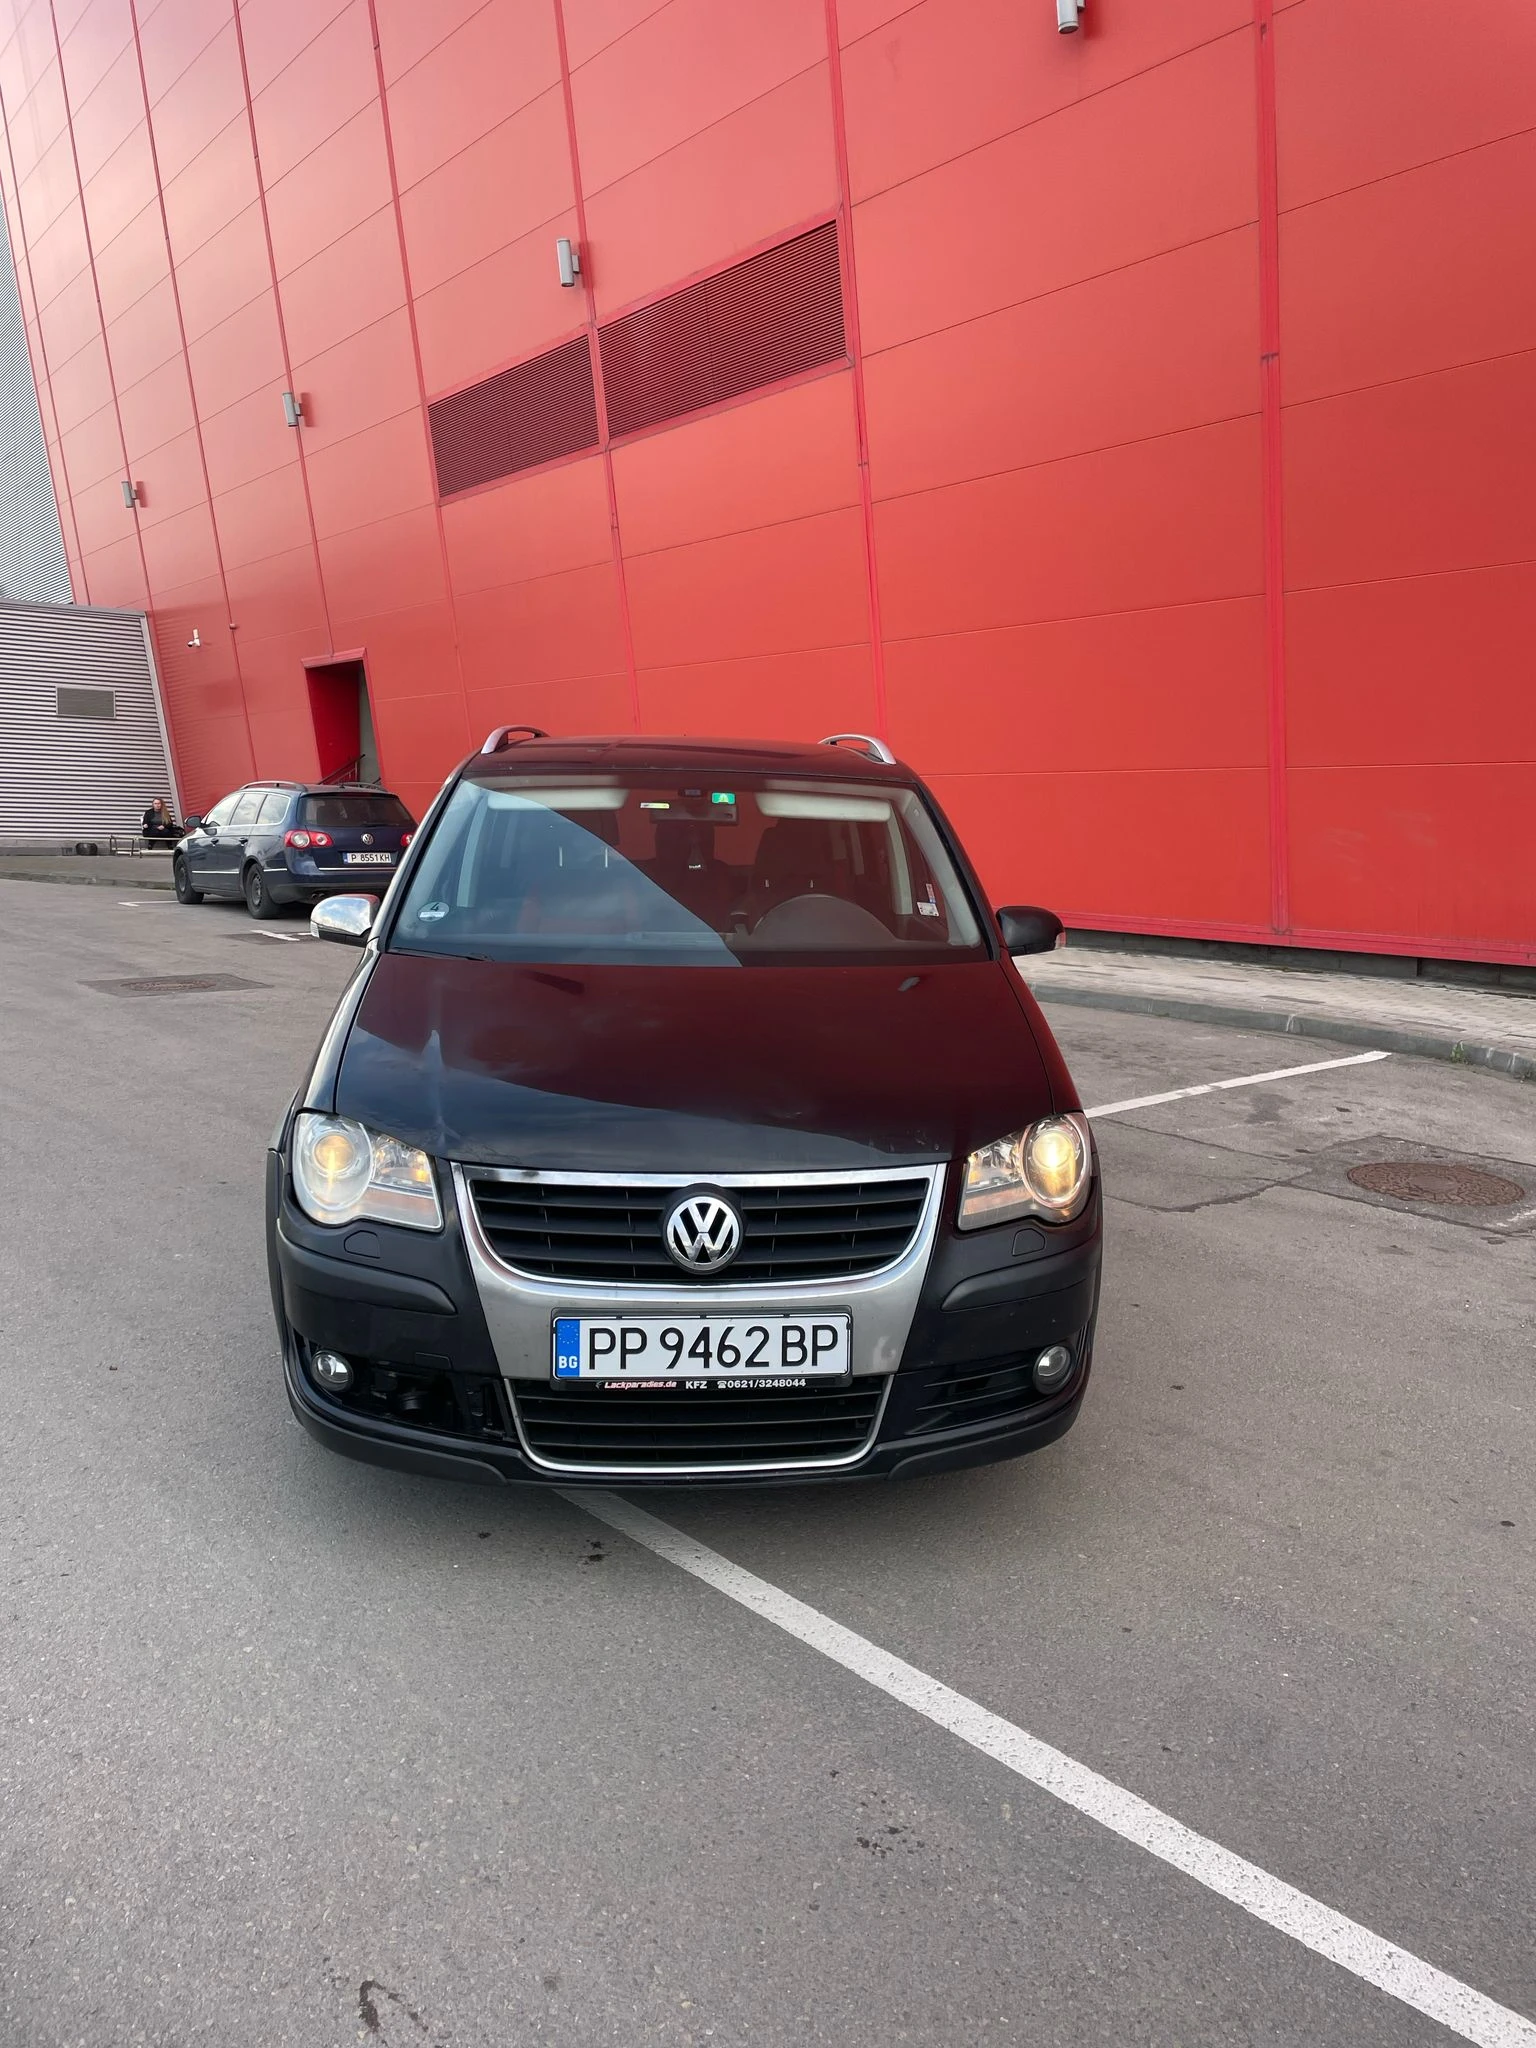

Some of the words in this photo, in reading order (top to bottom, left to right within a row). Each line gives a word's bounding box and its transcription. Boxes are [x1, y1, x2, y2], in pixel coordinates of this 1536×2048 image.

[431, 902, 440, 911] 4
[667, 1196, 740, 1271] VW
[588, 1327, 648, 1370] PP
[659, 1325, 770, 1370] 9462
[781, 1324, 838, 1368] BP
[558, 1355, 578, 1369] BG
[604, 1380, 677, 1390] Lackparadies.de
[685, 1380, 708, 1390] KFZ
[727, 1378, 807, 1389] 0621/3248044
